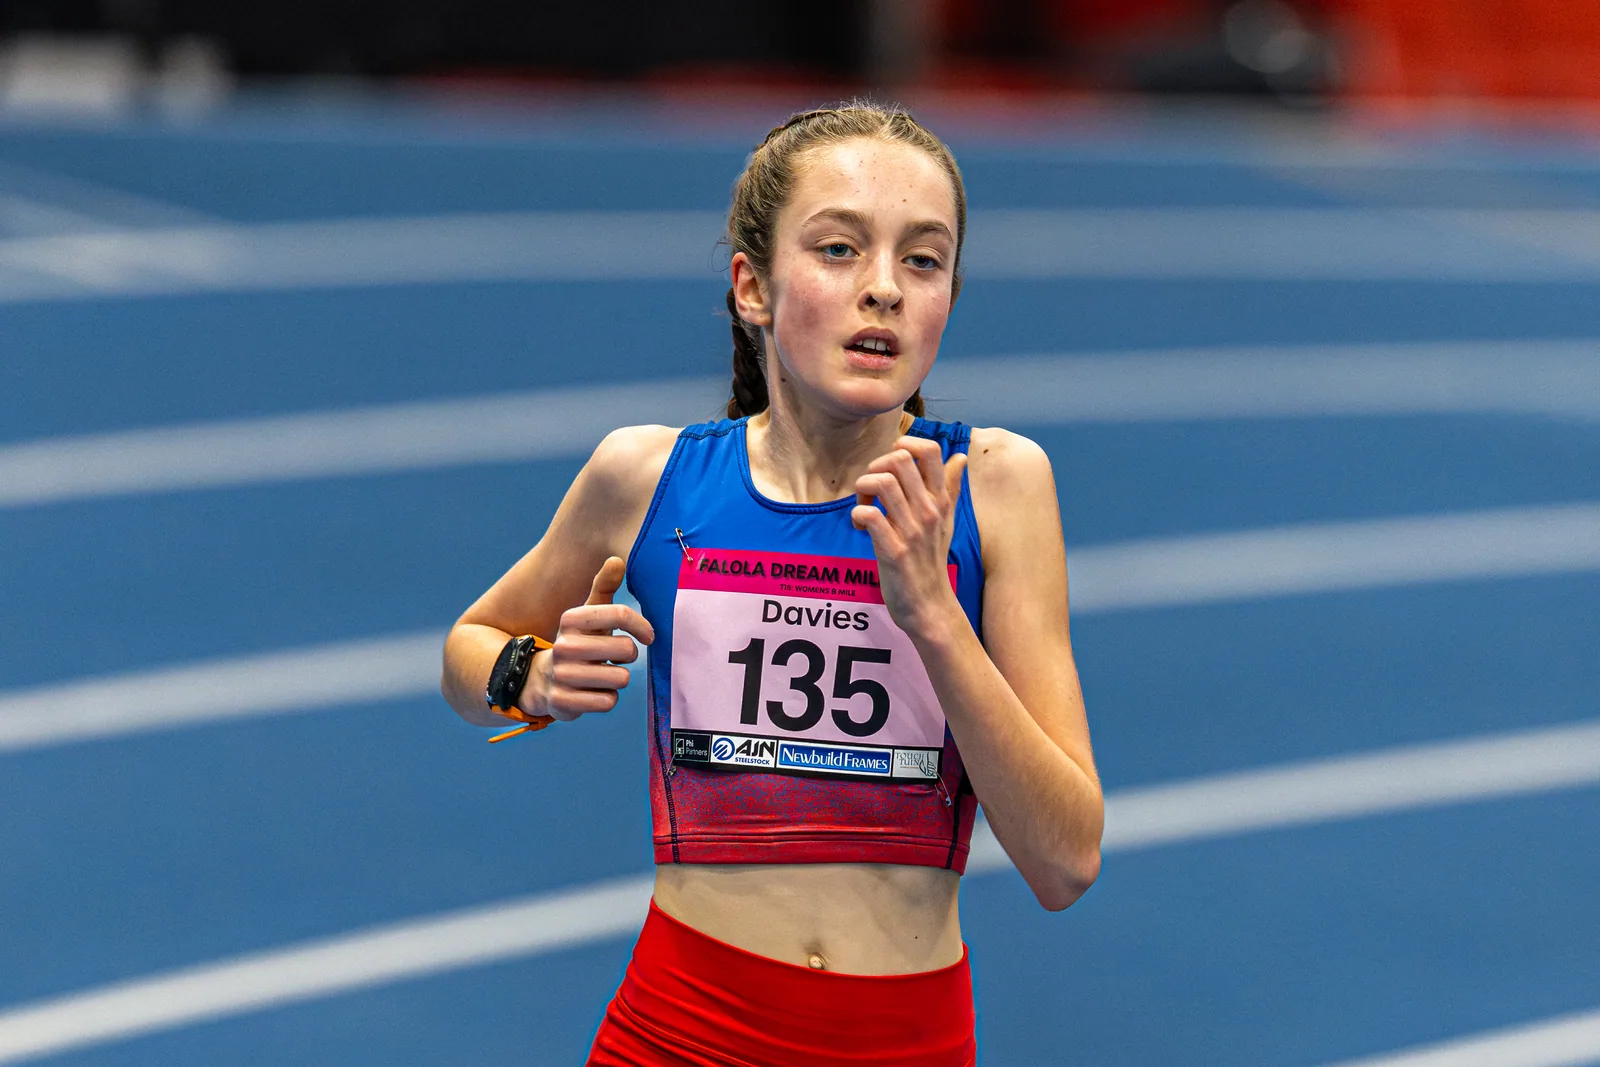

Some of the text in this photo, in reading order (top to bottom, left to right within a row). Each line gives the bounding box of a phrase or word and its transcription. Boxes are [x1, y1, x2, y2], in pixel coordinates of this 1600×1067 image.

[699, 558, 881, 588] FALOLA DREAM MIL
[795, 585, 830, 595] WOMENS
[838, 589, 856, 597] MILE
[762, 599, 870, 631] Davies
[728, 637, 892, 737] 135
[685, 739, 694, 747] Phi
[735, 739, 776, 758] AJN
[685, 747, 708, 757] Partners
[896, 752, 925, 760] TOUCH
[735, 757, 770, 765] STEELSTOCK
[844, 753, 888, 770] FRAMES
